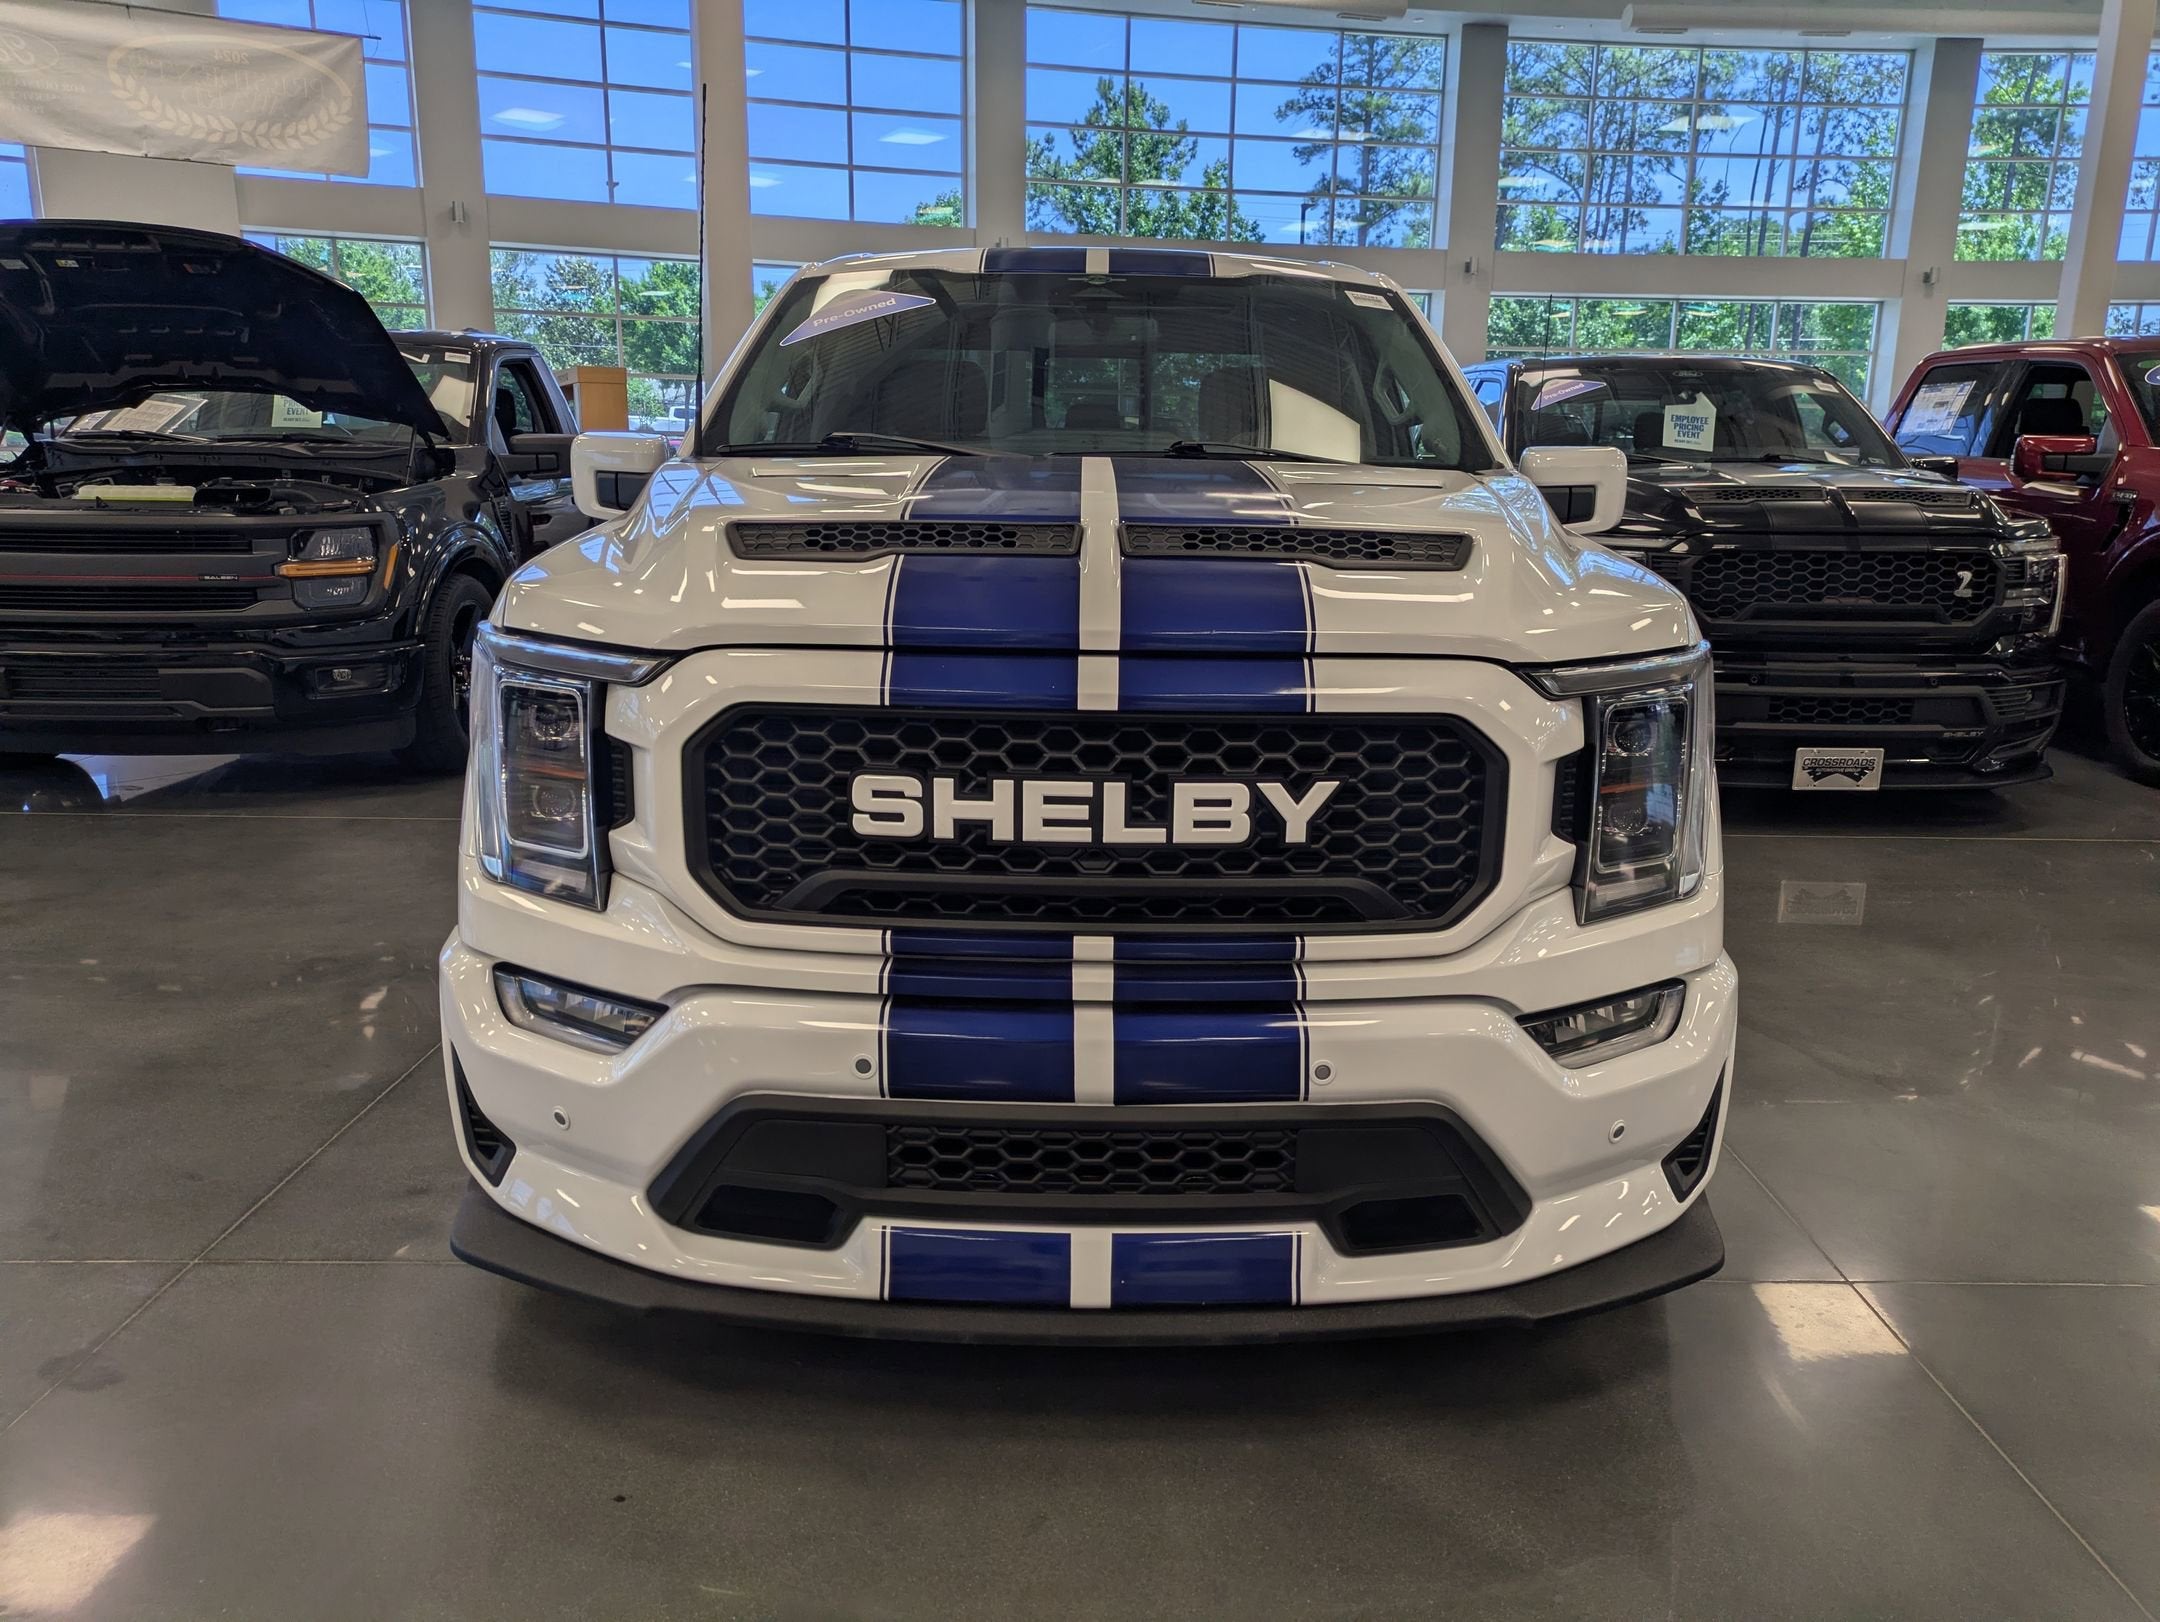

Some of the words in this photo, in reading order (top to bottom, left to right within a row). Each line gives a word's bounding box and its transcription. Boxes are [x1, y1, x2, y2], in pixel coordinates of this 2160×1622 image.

[812, 298, 897, 327] Pre-Owned
[1671, 414, 1709, 425] EMPLOYEE
[1673, 422, 1705, 432] PRICING
[1677, 430, 1701, 439] EVENT
[1802, 757, 1877, 767] CROSSROADS
[851, 774, 1341, 844] SHELBY
